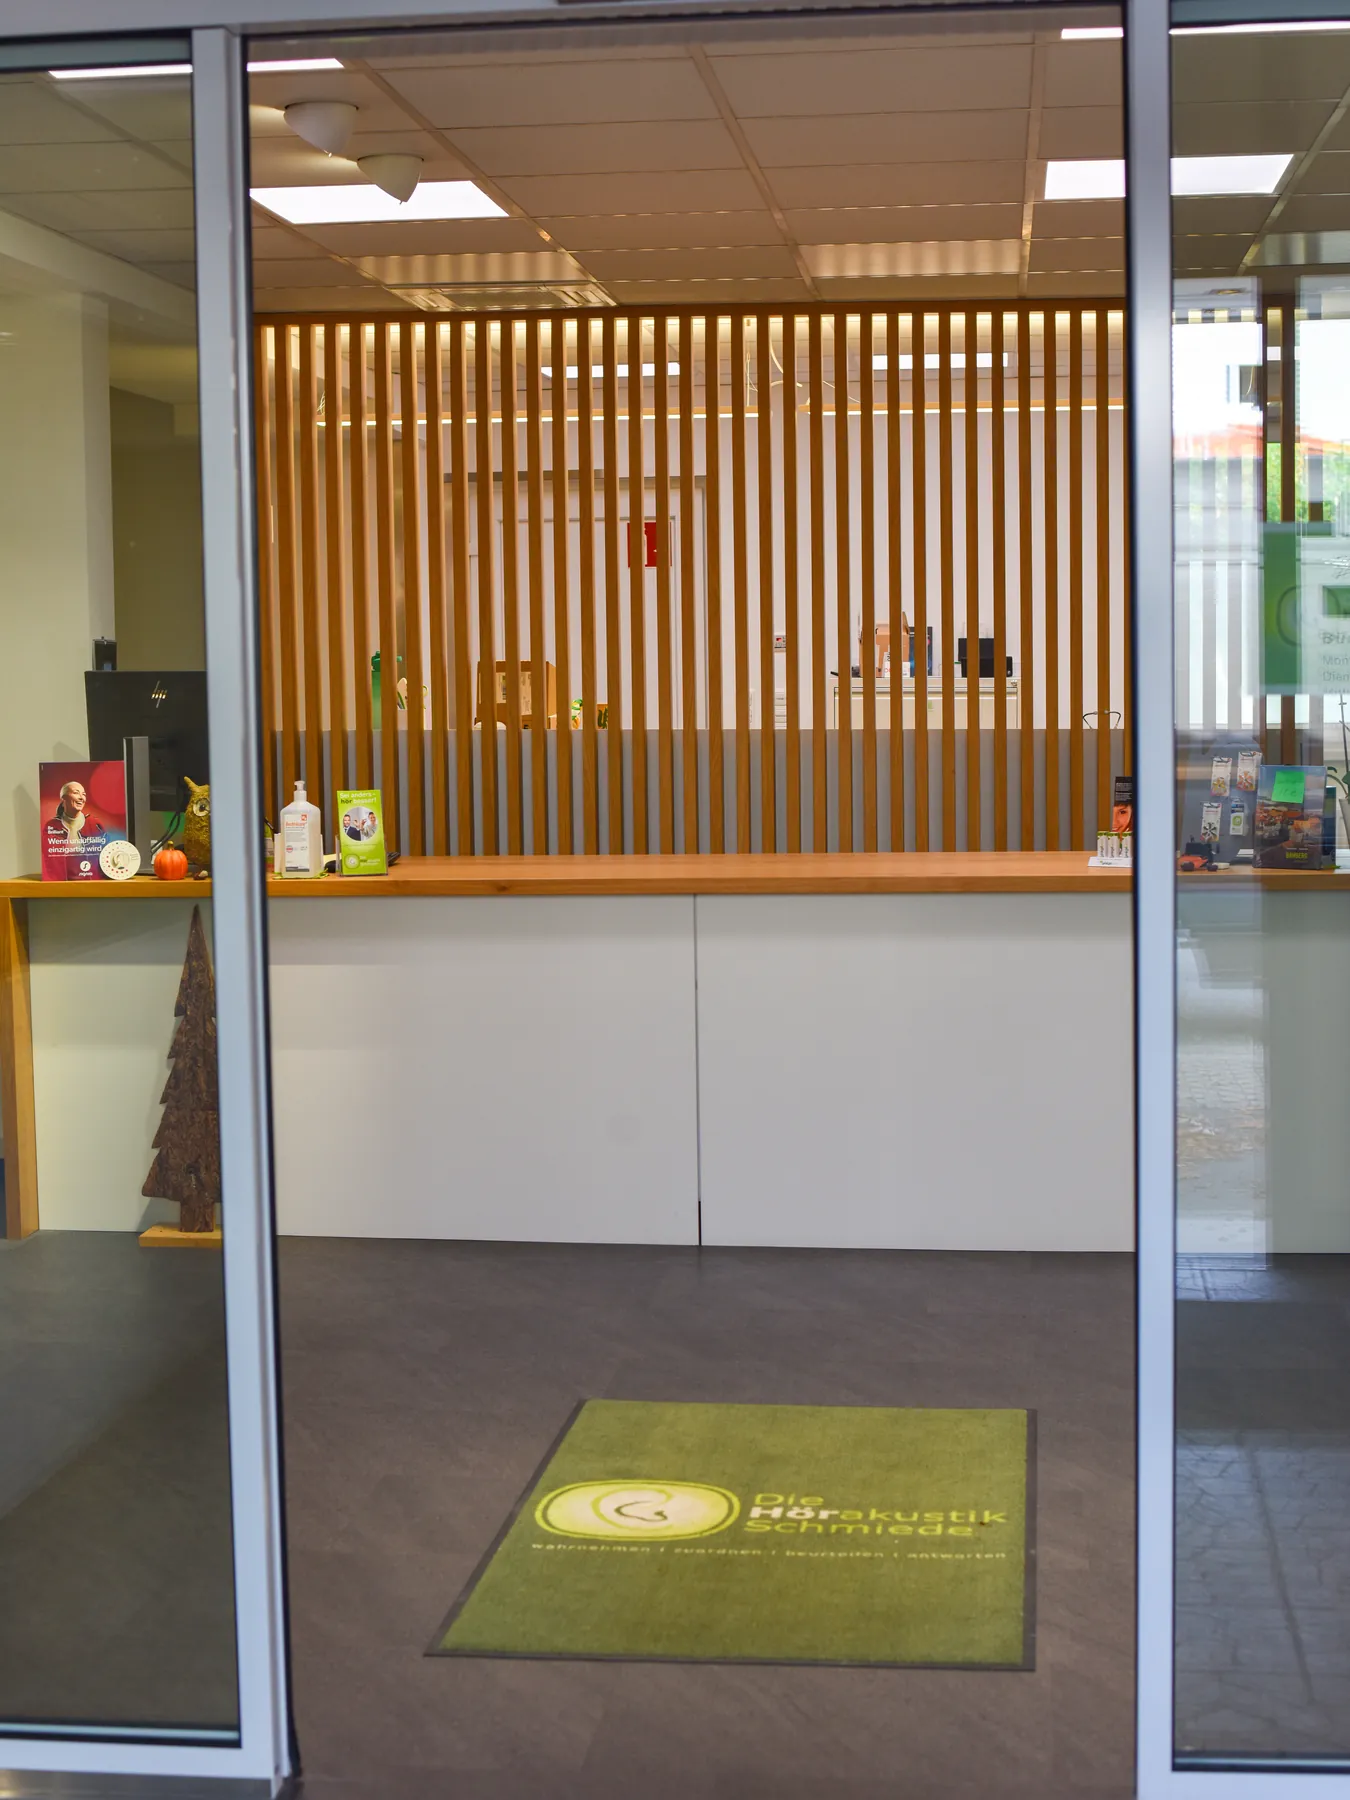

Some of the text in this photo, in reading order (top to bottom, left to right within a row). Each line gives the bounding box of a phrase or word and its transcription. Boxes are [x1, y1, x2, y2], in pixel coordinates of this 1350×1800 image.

[1322, 655, 1350, 666] Mon
[754, 1492, 825, 1506] Die
[749, 1506, 1008, 1523] Hörakustik
[743, 1519, 974, 1536] Schmiede
[532, 1542, 650, 1552] wahrnehmen
[906, 1551, 1007, 1560] antworten
